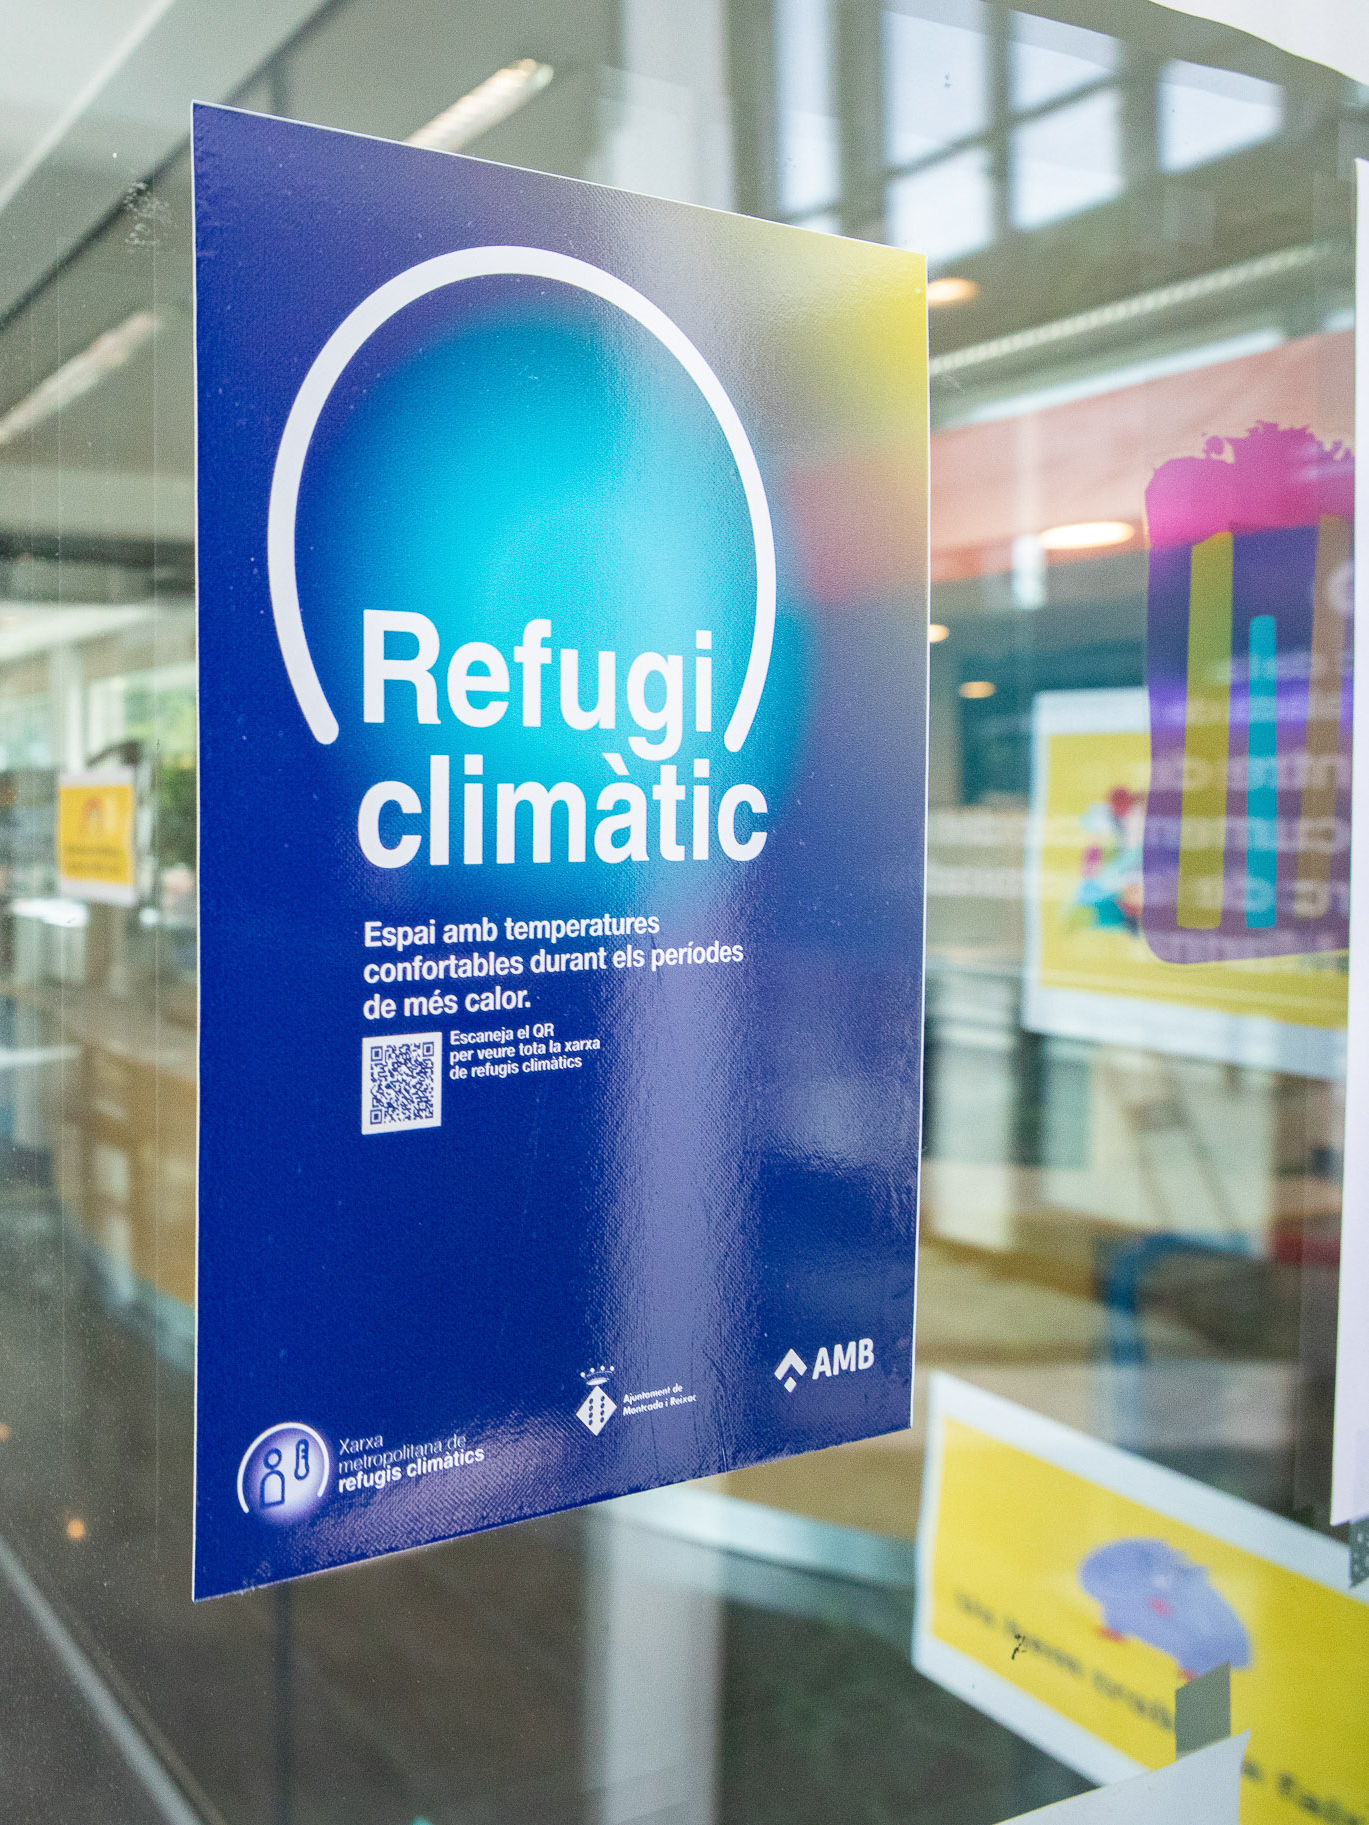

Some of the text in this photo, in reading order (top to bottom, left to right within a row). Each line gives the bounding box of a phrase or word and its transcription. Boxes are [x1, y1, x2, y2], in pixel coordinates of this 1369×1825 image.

[363, 609, 712, 761] Refugi
[357, 752, 768, 869] climàtic
[364, 913, 660, 952] Espai amb temperatures
[363, 940, 743, 983] confortables durant els períodes
[363, 986, 531, 1020] de més calor.
[450, 1023, 554, 1045] Escaneja el QR
[450, 1038, 600, 1065] per veure tota la xarxa
[449, 1055, 582, 1079] de refugis climàtics
[812, 1338, 874, 1380] AMB
[623, 1383, 683, 1404] Ajuntament de
[623, 1400, 663, 1416] Montcada
[670, 1394, 697, 1406] Reixac
[339, 1435, 383, 1455] Xarxa
[339, 1433, 466, 1474] metropolitana de
[338, 1448, 485, 1493] refugis climàtics
